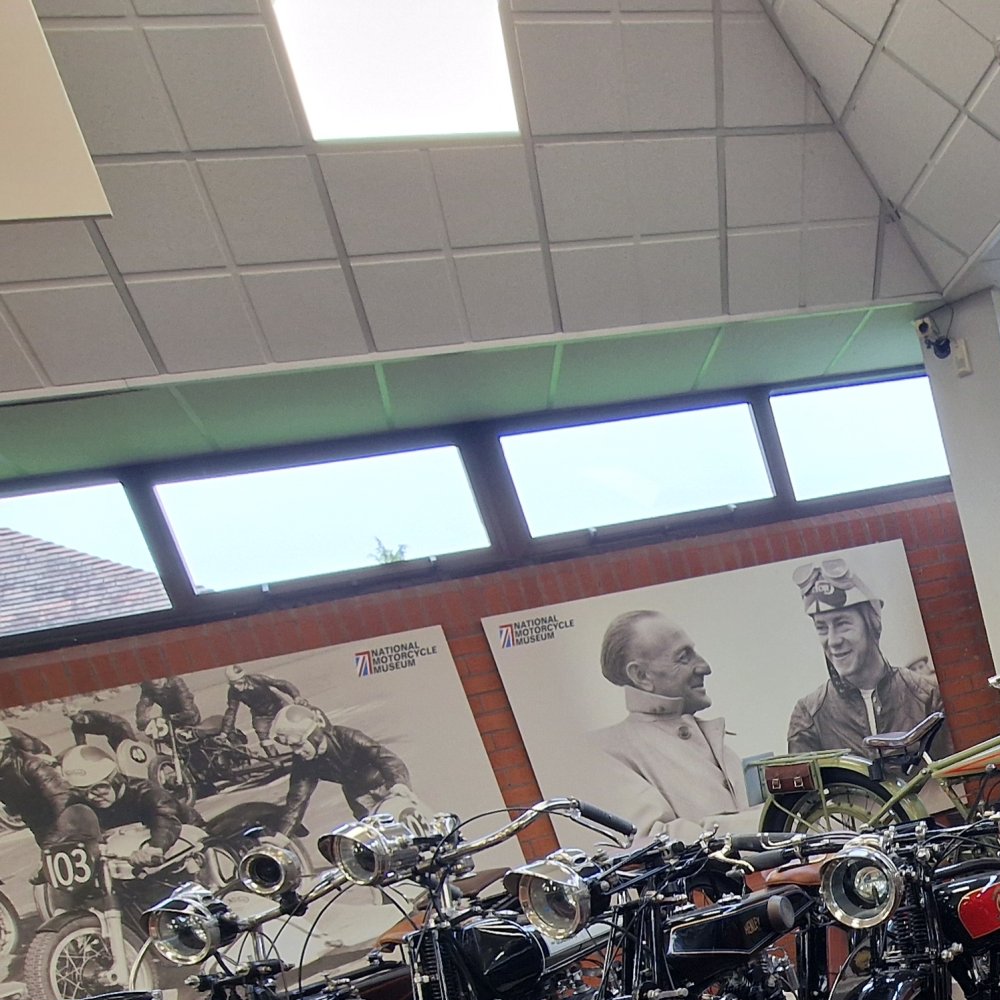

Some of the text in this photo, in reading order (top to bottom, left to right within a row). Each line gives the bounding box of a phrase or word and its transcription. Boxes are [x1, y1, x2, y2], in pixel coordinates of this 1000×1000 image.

[514, 615, 558, 629] NATIONAL
[515, 619, 575, 637] MOTORCYCLE
[515, 632, 555, 646] MUSEUM
[371, 641, 419, 657] NATIONAL
[372, 646, 438, 665] MOTORCYCLE
[373, 659, 416, 674] MUSEUM
[46, 848, 92, 889] 103
